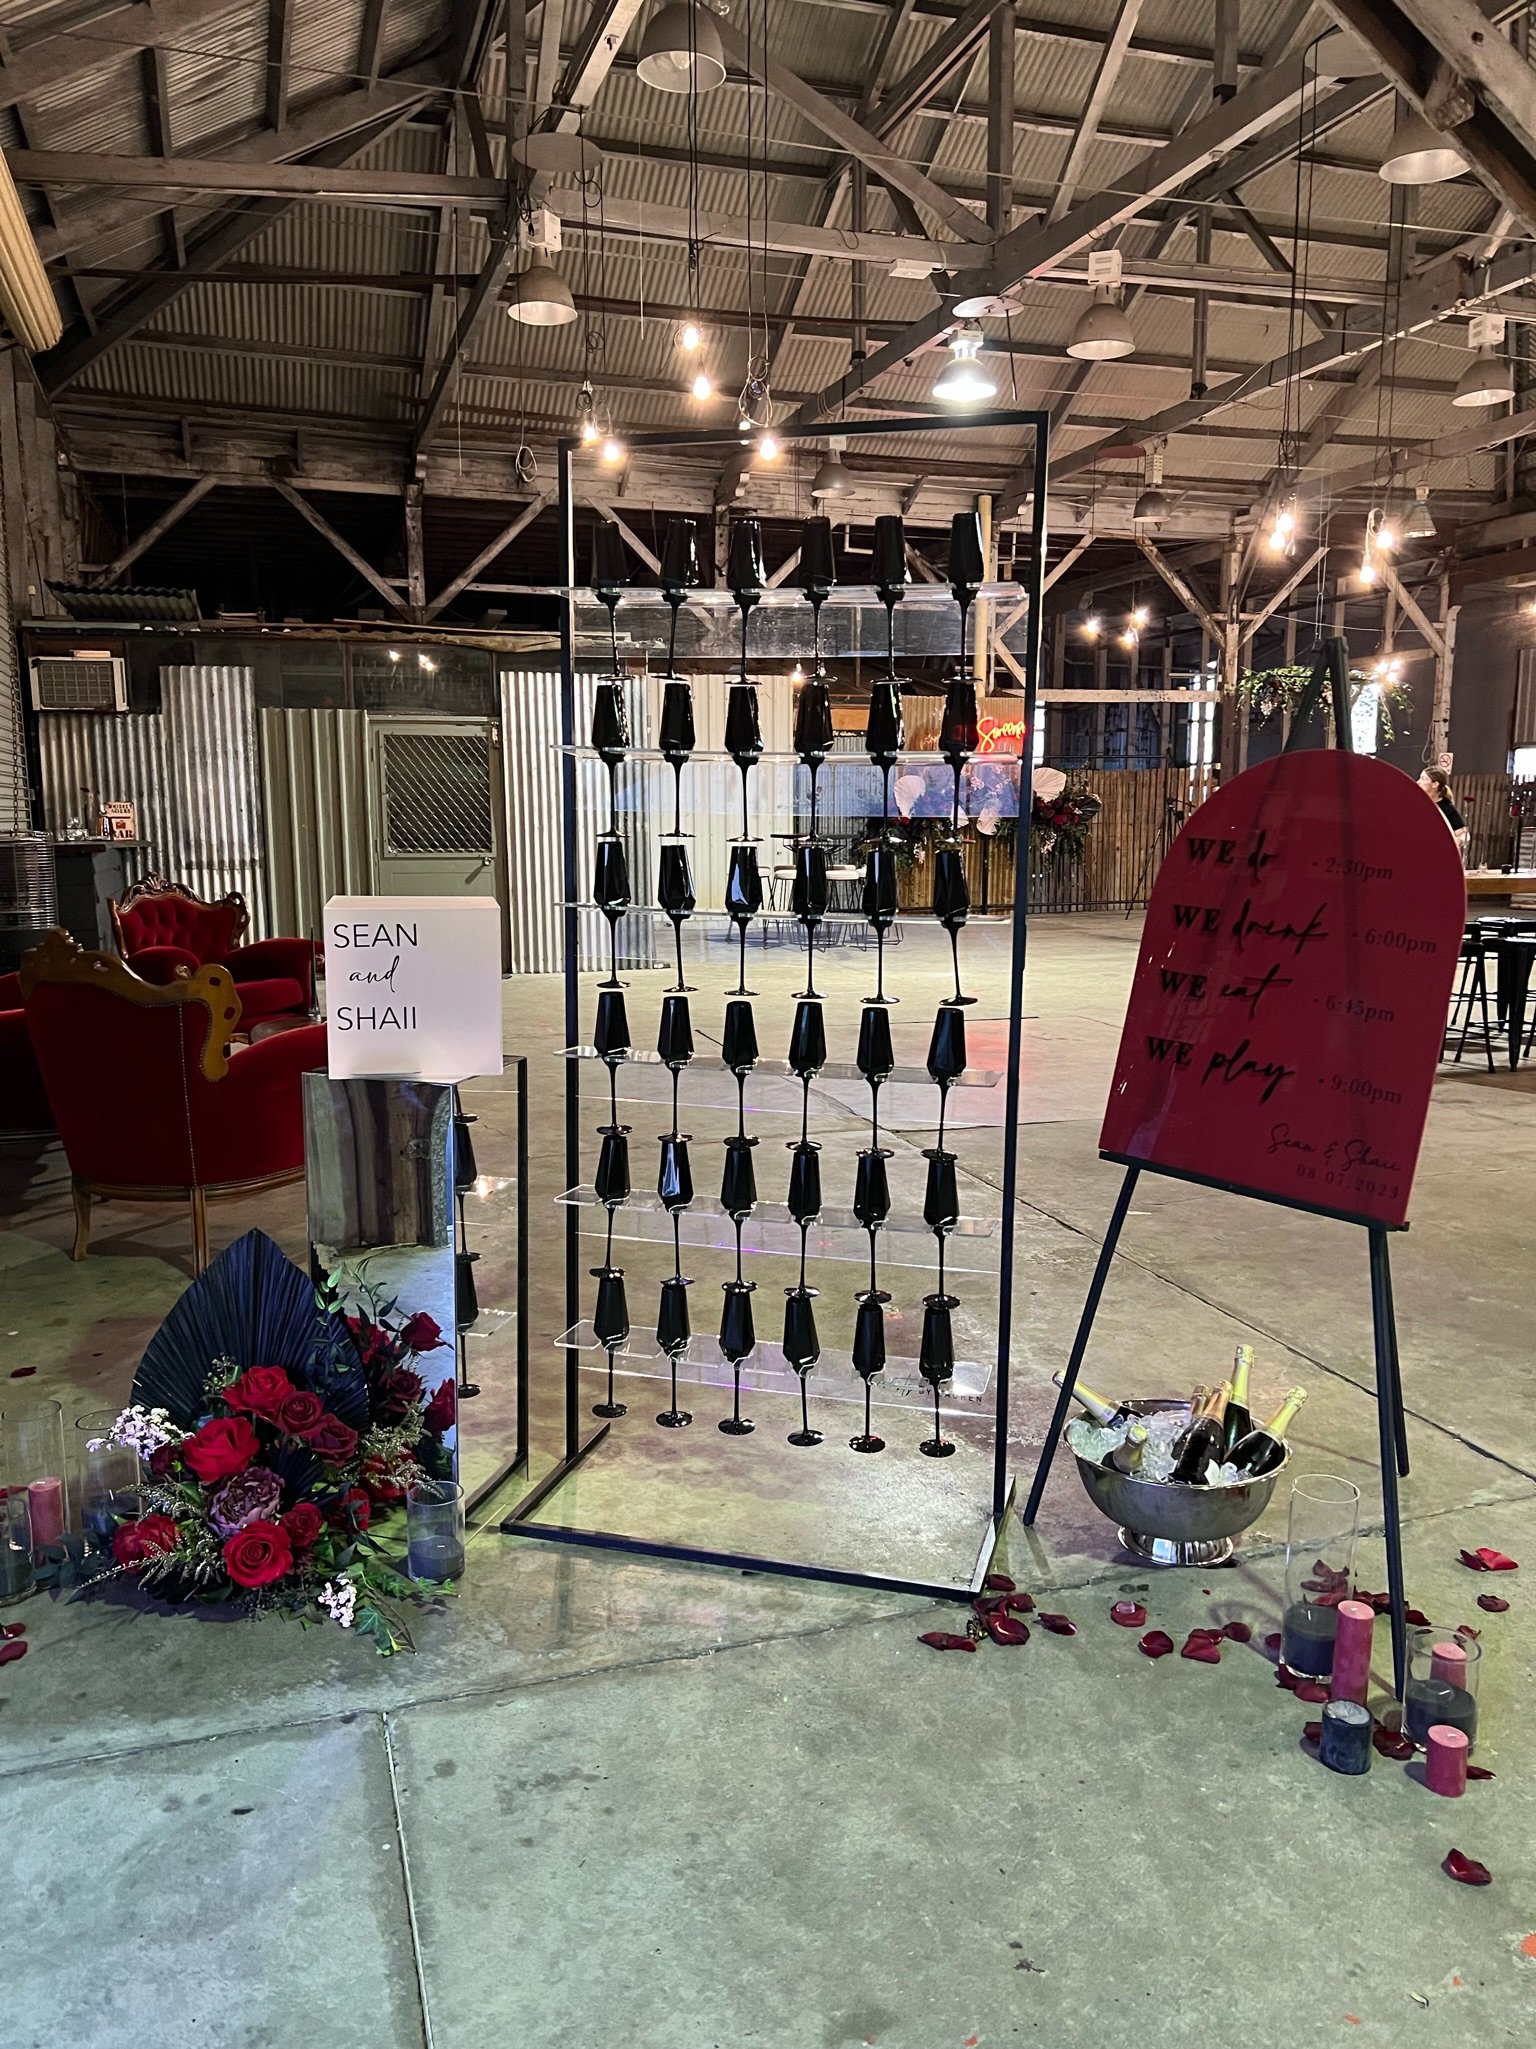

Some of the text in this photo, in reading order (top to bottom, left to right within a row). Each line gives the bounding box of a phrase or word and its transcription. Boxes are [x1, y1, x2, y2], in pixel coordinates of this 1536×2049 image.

[1187, 828, 1393, 884] WE do 2:30pm
[333, 923, 418, 949] SEAN
[1173, 897, 1437, 955] WE drink 6:00pm
[349, 955, 400, 993] and
[1159, 963, 1395, 1023] WE eat 6:45pm
[337, 1006, 417, 1031] SHAII
[1146, 1035, 1402, 1105] WE play 9:00pm
[1266, 1122, 1316, 1154] Sean
